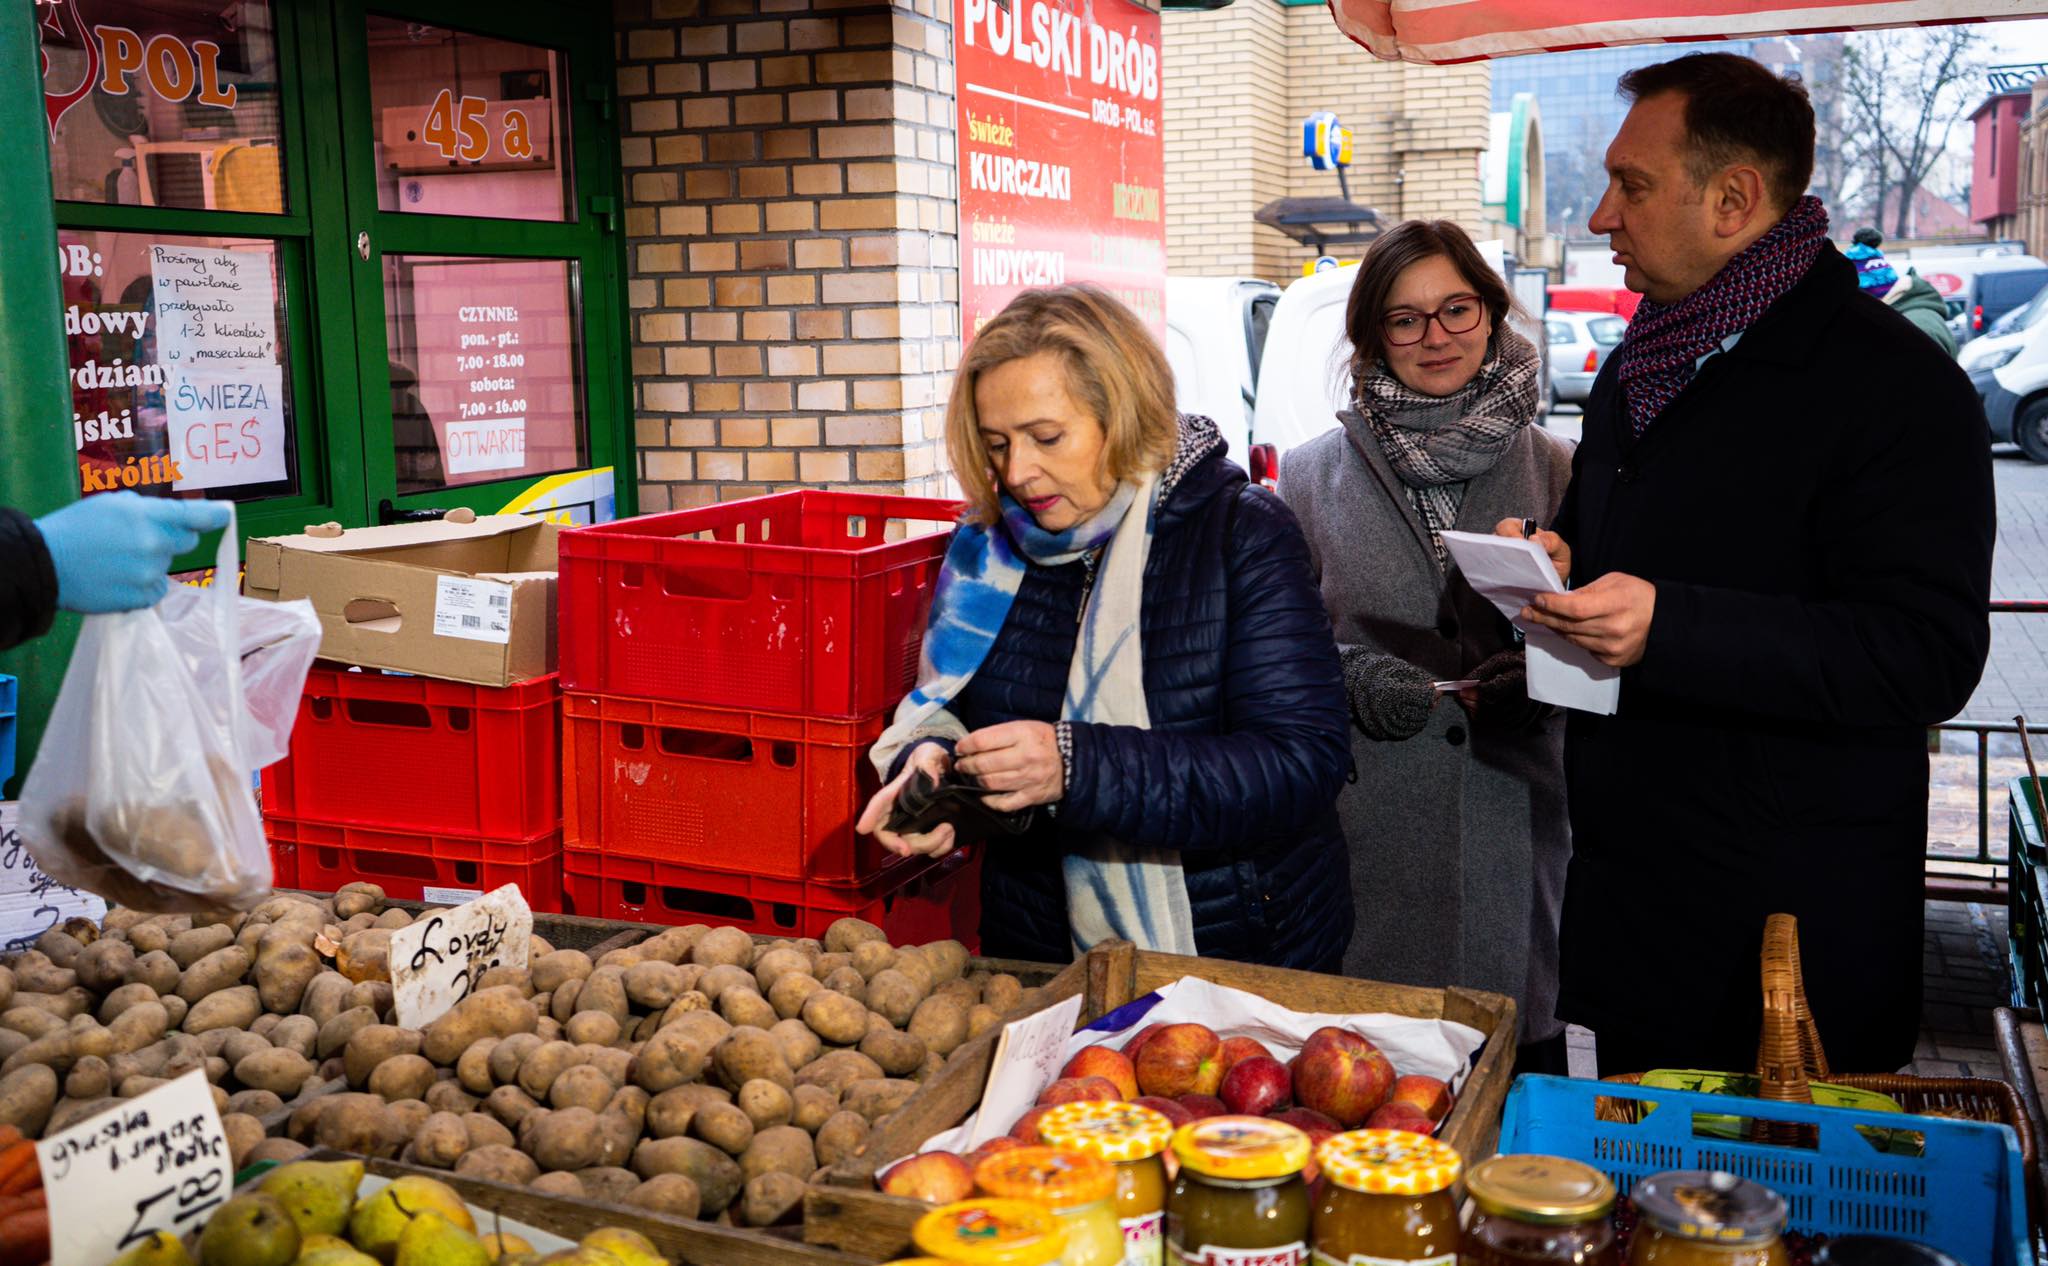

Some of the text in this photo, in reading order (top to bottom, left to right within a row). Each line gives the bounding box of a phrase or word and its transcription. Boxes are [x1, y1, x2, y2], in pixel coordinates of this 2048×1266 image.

[964, 0, 1158, 100] POLSKI DRÓB
[94, 25, 237, 109] POL
[424, 89, 532, 161] 45 a
[968, 112, 1013, 148] świeże
[970, 152, 1071, 201] KURCZAKI
[972, 215, 1016, 245] świeże
[155, 247, 239, 276] Prosimy aby
[972, 248, 1065, 286] INDYCZKI
[159, 275, 243, 294] w pawilonie
[159, 300, 235, 322] przebywało
[459, 306, 518, 322] CZYNNE:
[180, 322, 267, 339] 1-2 klientów
[461, 333, 489, 349] pon.
[168, 351, 181, 360] w
[457, 356, 484, 372] 7.00
[493, 354, 525, 368] 18.00
[470, 377, 515, 393] sobota:
[459, 403, 486, 419] 7.00
[495, 399, 527, 414] 16.00
[185, 416, 261, 464] GĘŚ
[447, 428, 526, 459] OTWARTE
[82, 454, 184, 493] królik
